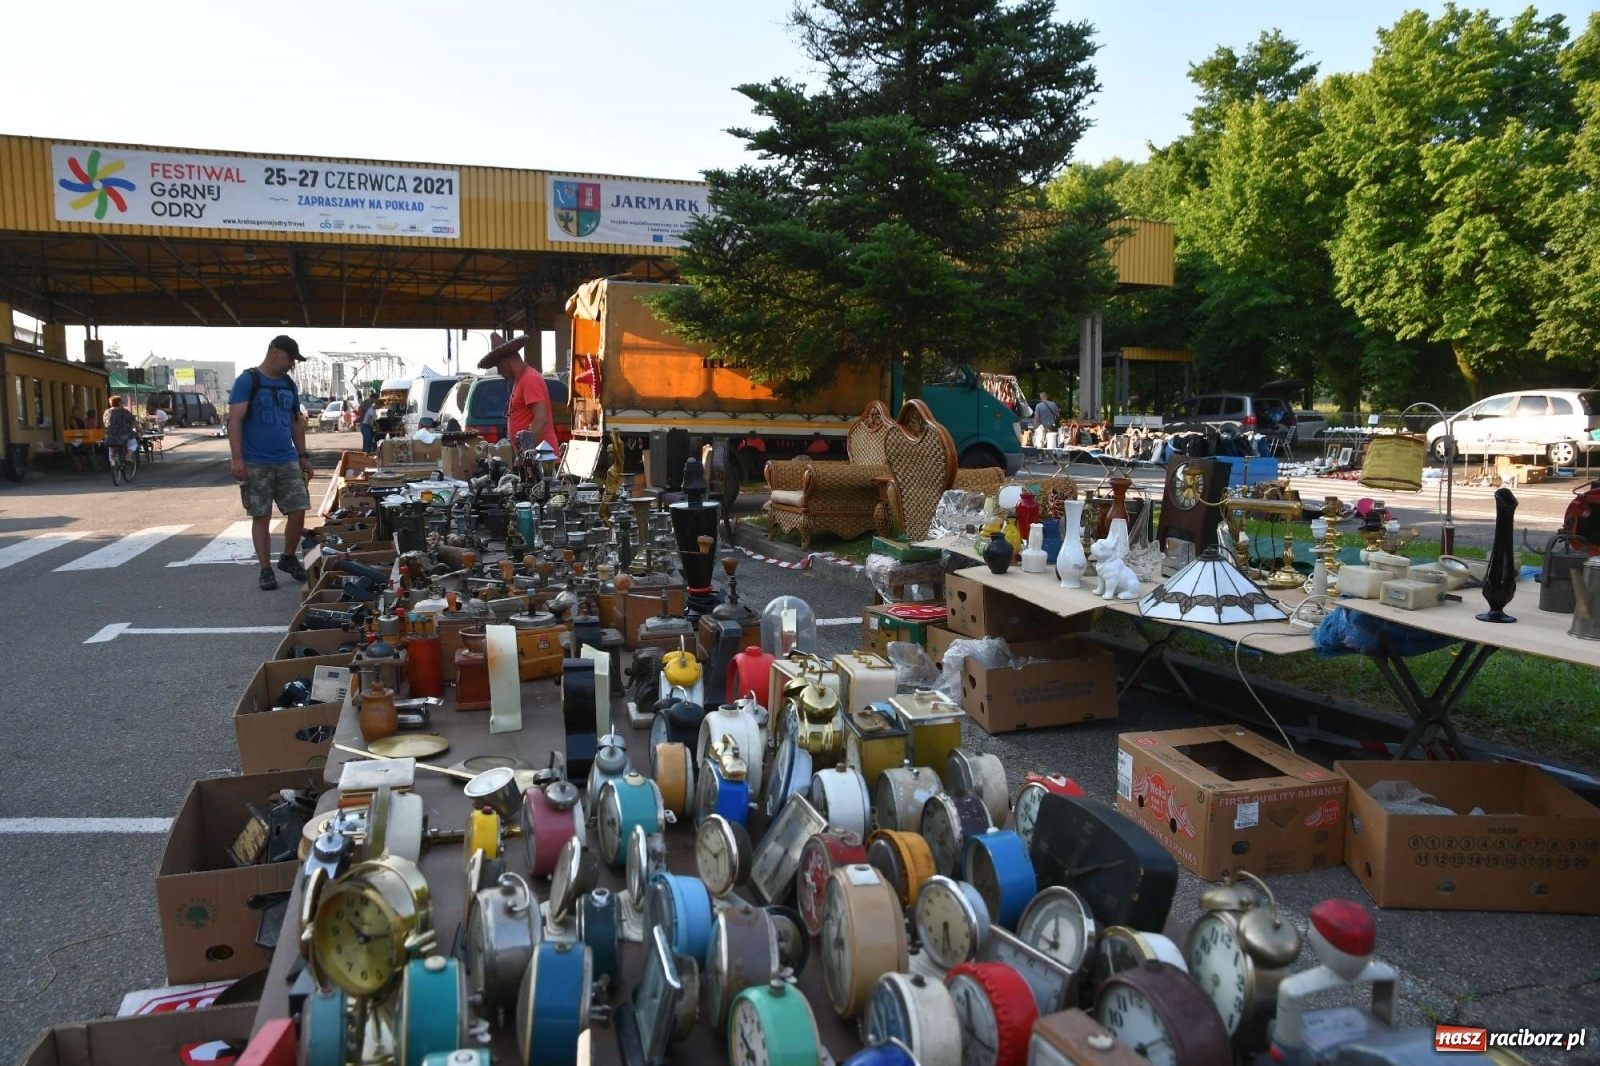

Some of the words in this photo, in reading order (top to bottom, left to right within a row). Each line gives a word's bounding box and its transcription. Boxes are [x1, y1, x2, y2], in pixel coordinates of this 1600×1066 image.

[150, 162, 246, 183] FESTIWAL
[264, 167, 319, 188] 25-27
[325, 171, 407, 193] CZERWCA
[413, 176, 453, 195] 2021
[150, 182, 221, 201] GÓRNEJ
[151, 201, 207, 219] ODRY
[297, 195, 366, 209] ZAPRASZAMY
[368, 199, 382, 210] NA
[385, 200, 424, 212] POKŁAD
[611, 195, 700, 212] JARMARK
[1220, 795, 1250, 807] FIRST
[1253, 790, 1296, 804] QUALITY
[1298, 785, 1344, 798] BANANAS
